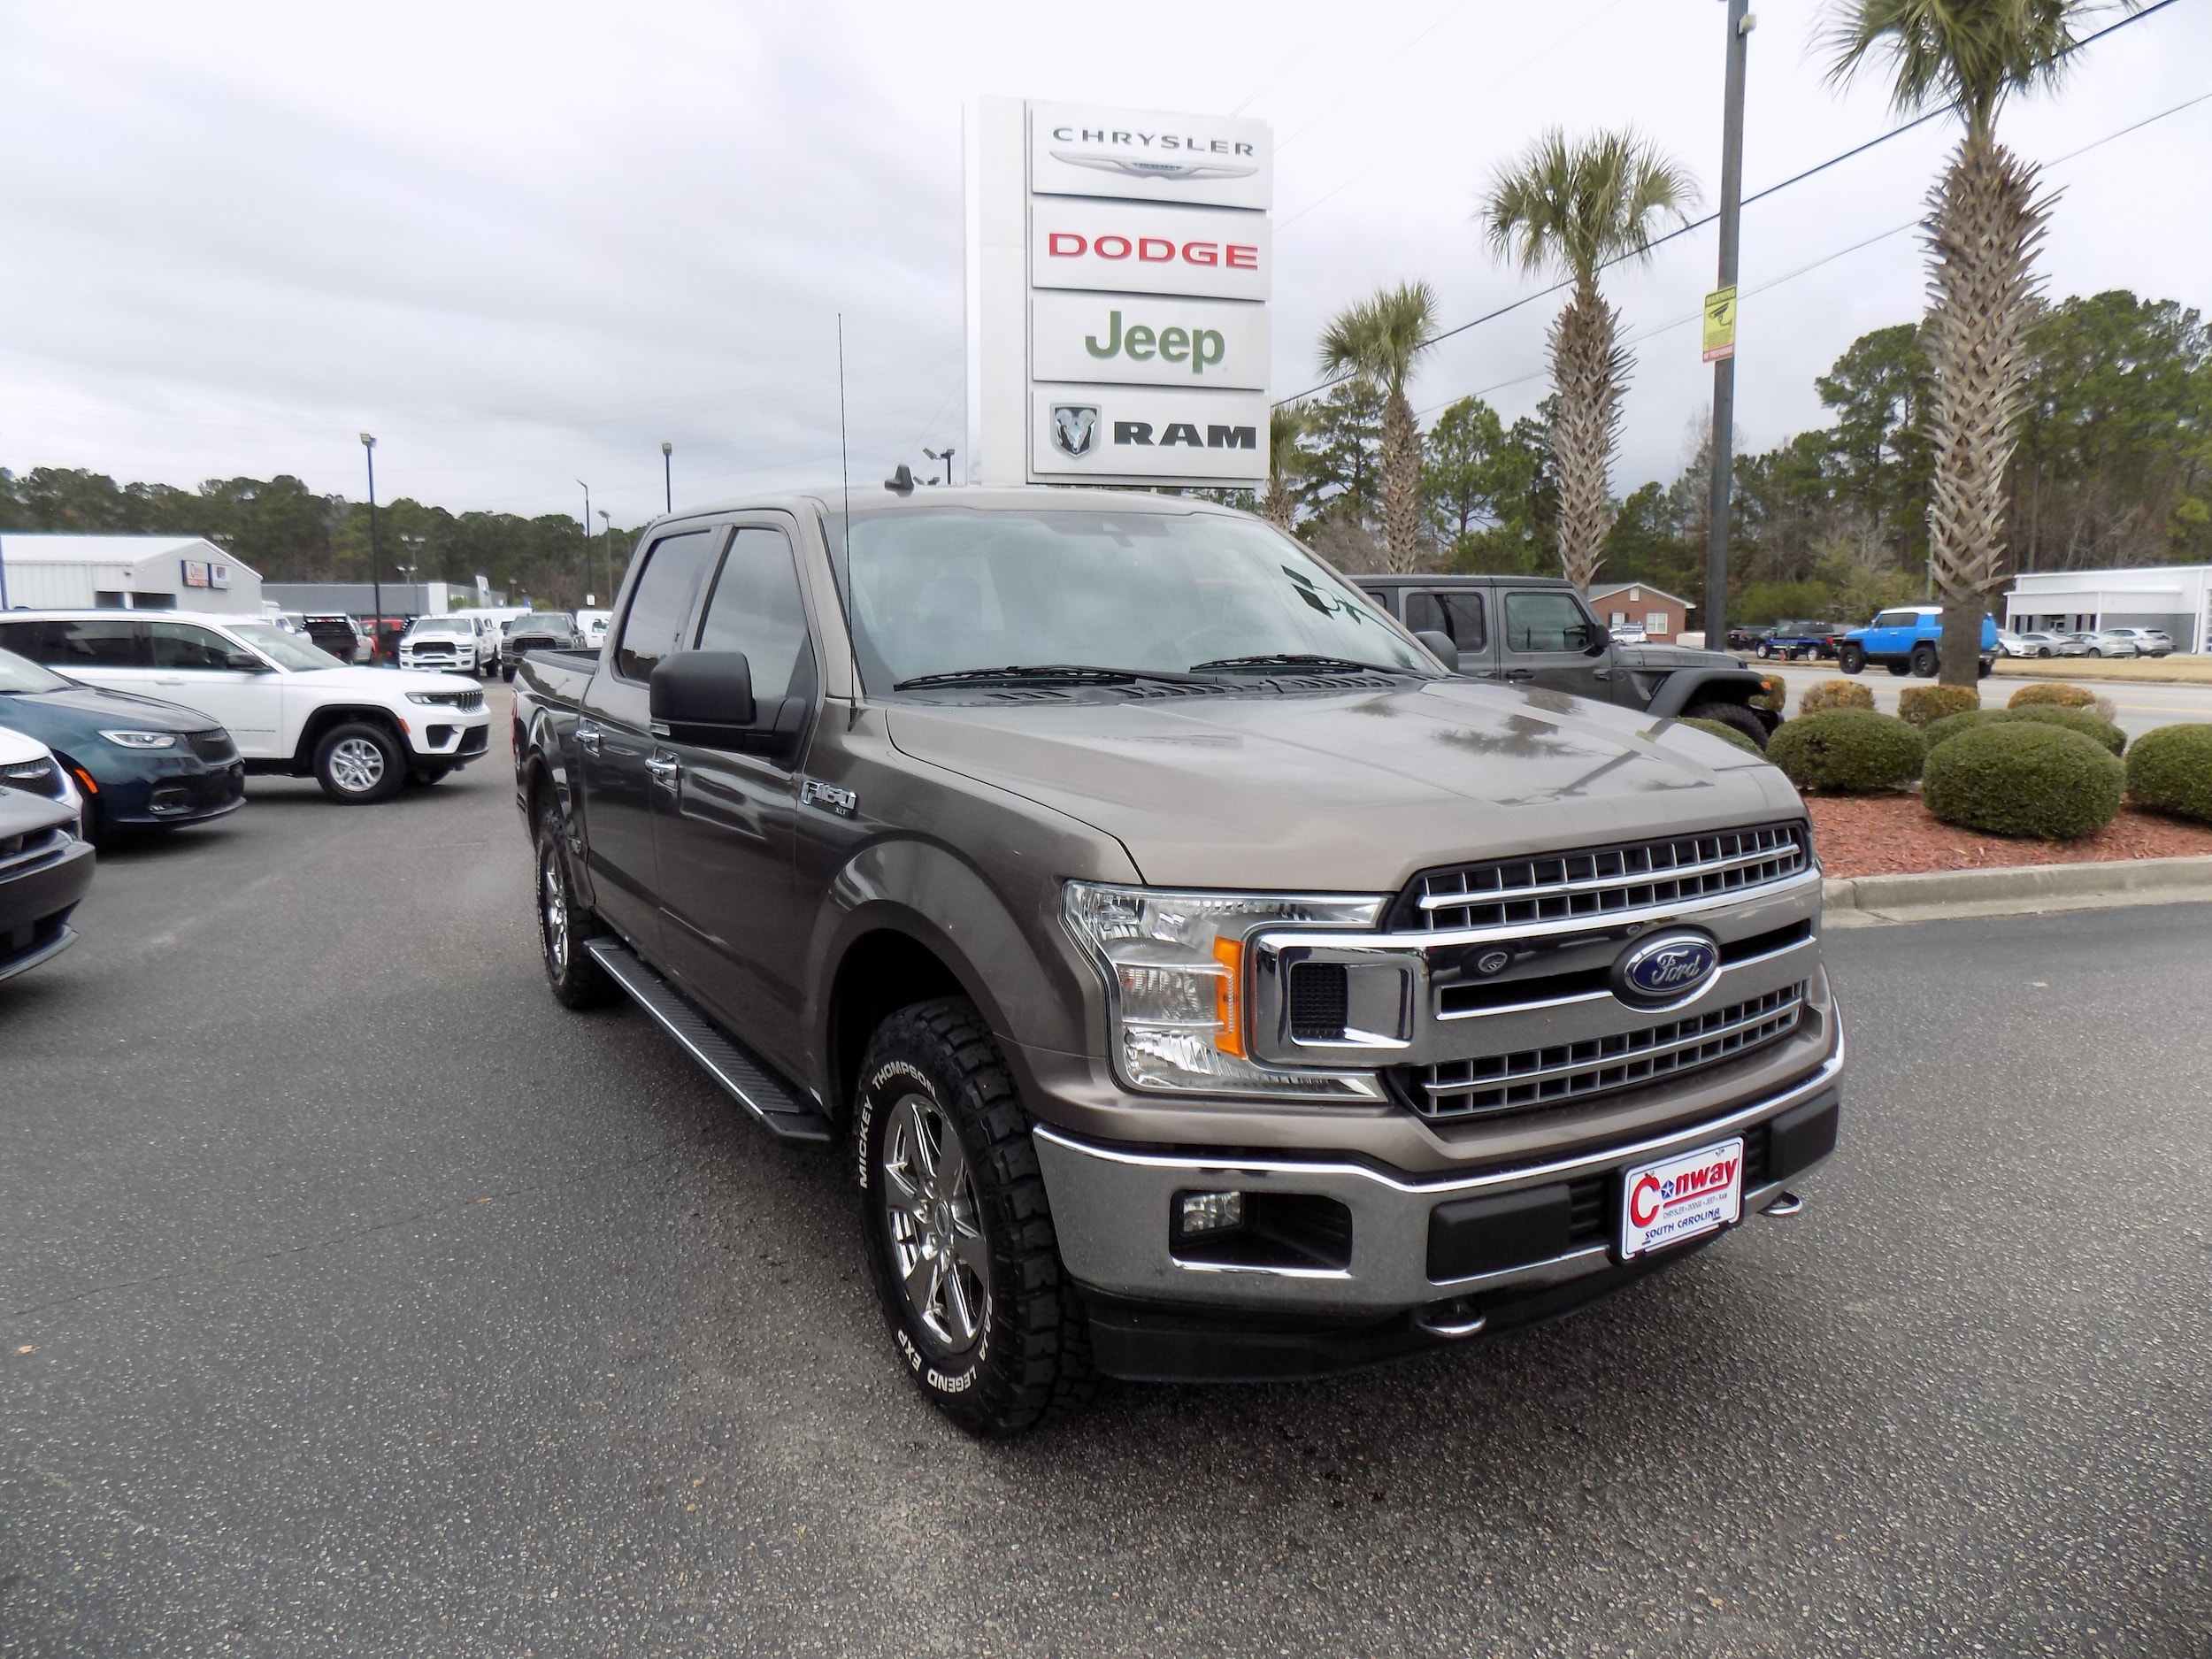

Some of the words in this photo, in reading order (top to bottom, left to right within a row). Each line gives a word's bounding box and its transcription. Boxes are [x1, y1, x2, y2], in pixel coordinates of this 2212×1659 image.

[1053, 127, 1255, 157] CHRYSLER
[1048, 233, 1258, 271] DODGE
[1085, 311, 1225, 374] Jeep
[1114, 421, 1256, 450] RAM
[834, 806, 847, 816] XLT
[1651, 949, 1701, 985] Ford
[858, 1094, 873, 1189] MICKEY
[872, 1061, 937, 1099] THOMPSON
[1645, 1223, 1675, 1240] SOUTH
[1677, 1207, 1720, 1228] CAROLINA
[897, 1329, 922, 1371] EXP
[927, 1364, 977, 1393] LEGEND
